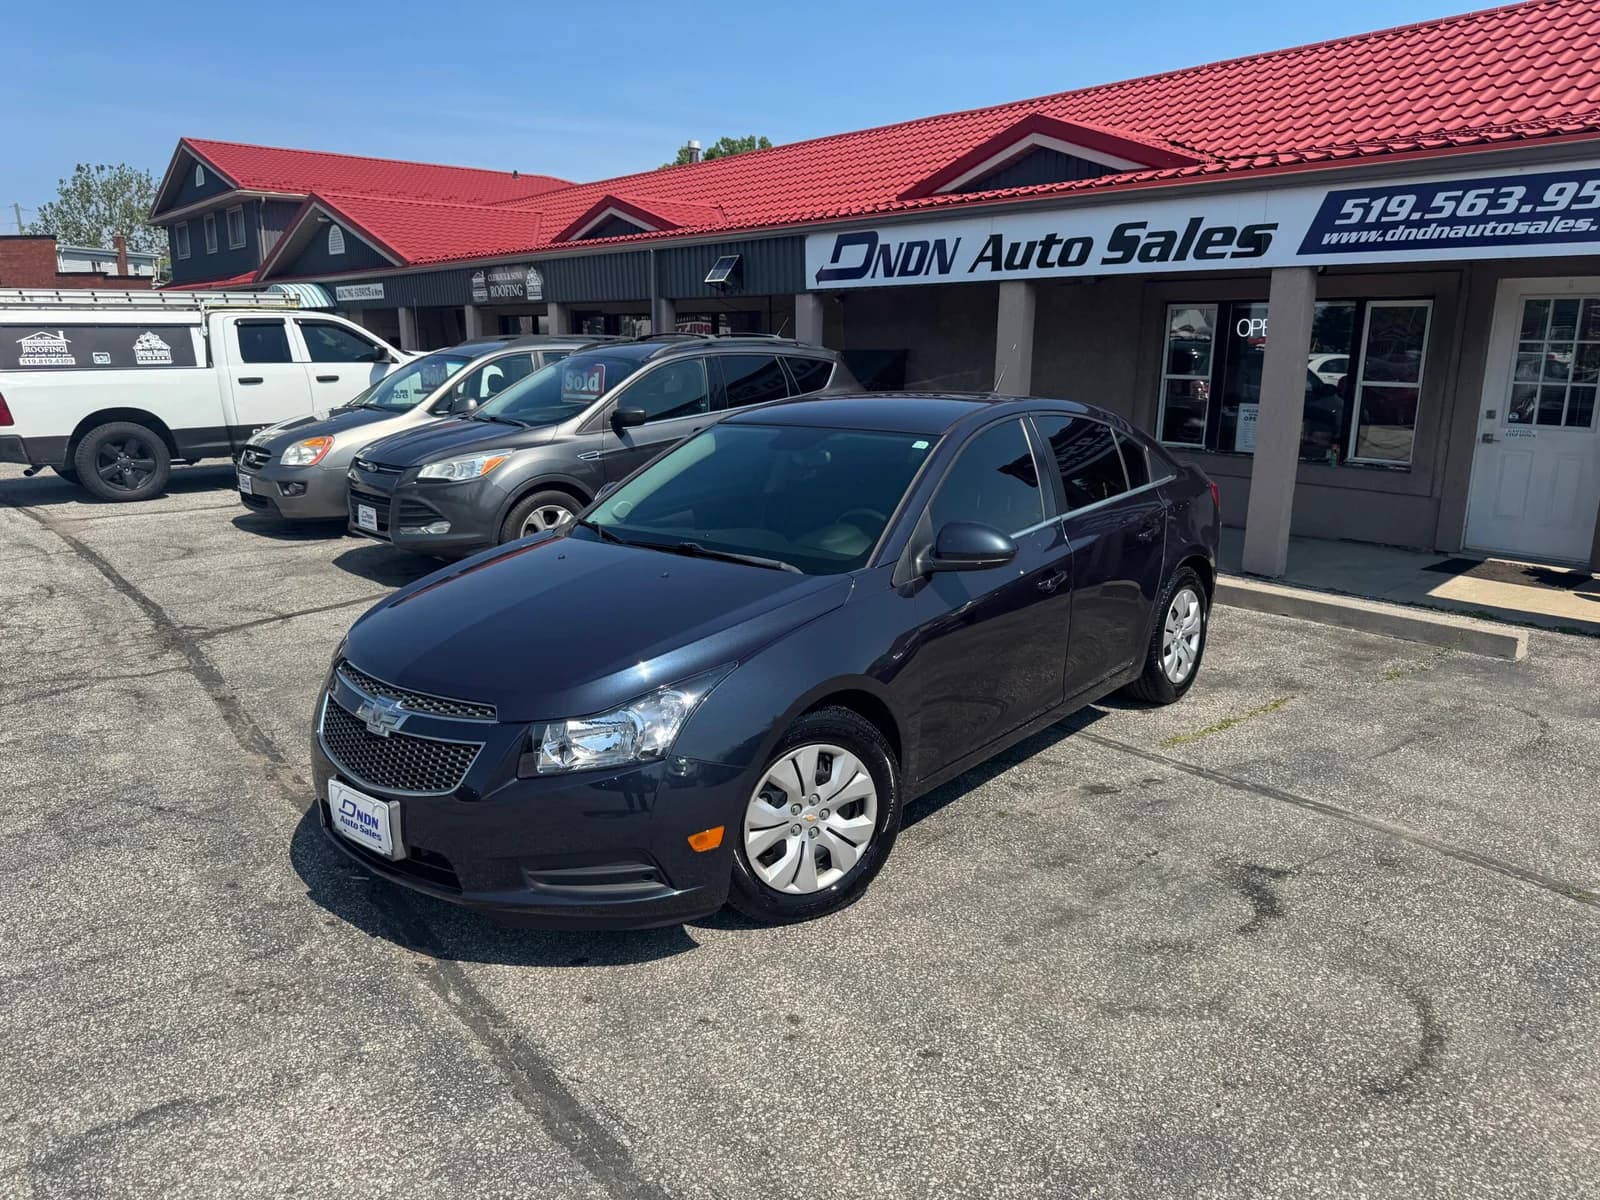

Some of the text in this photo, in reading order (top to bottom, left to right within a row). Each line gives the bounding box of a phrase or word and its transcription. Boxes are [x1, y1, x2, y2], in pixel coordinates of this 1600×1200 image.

[1335, 180, 1600, 225] 519.563.95
[1321, 216, 1598, 245] www.dndnautosales.
[815, 217, 1278, 285] DNDN Auto Sales
[490, 283, 524, 298] ROOFING
[1236, 318, 1268, 337] OPE
[564, 369, 599, 391] Sold
[338, 799, 379, 830] DNDN
[340, 815, 382, 842] Auto Sales
